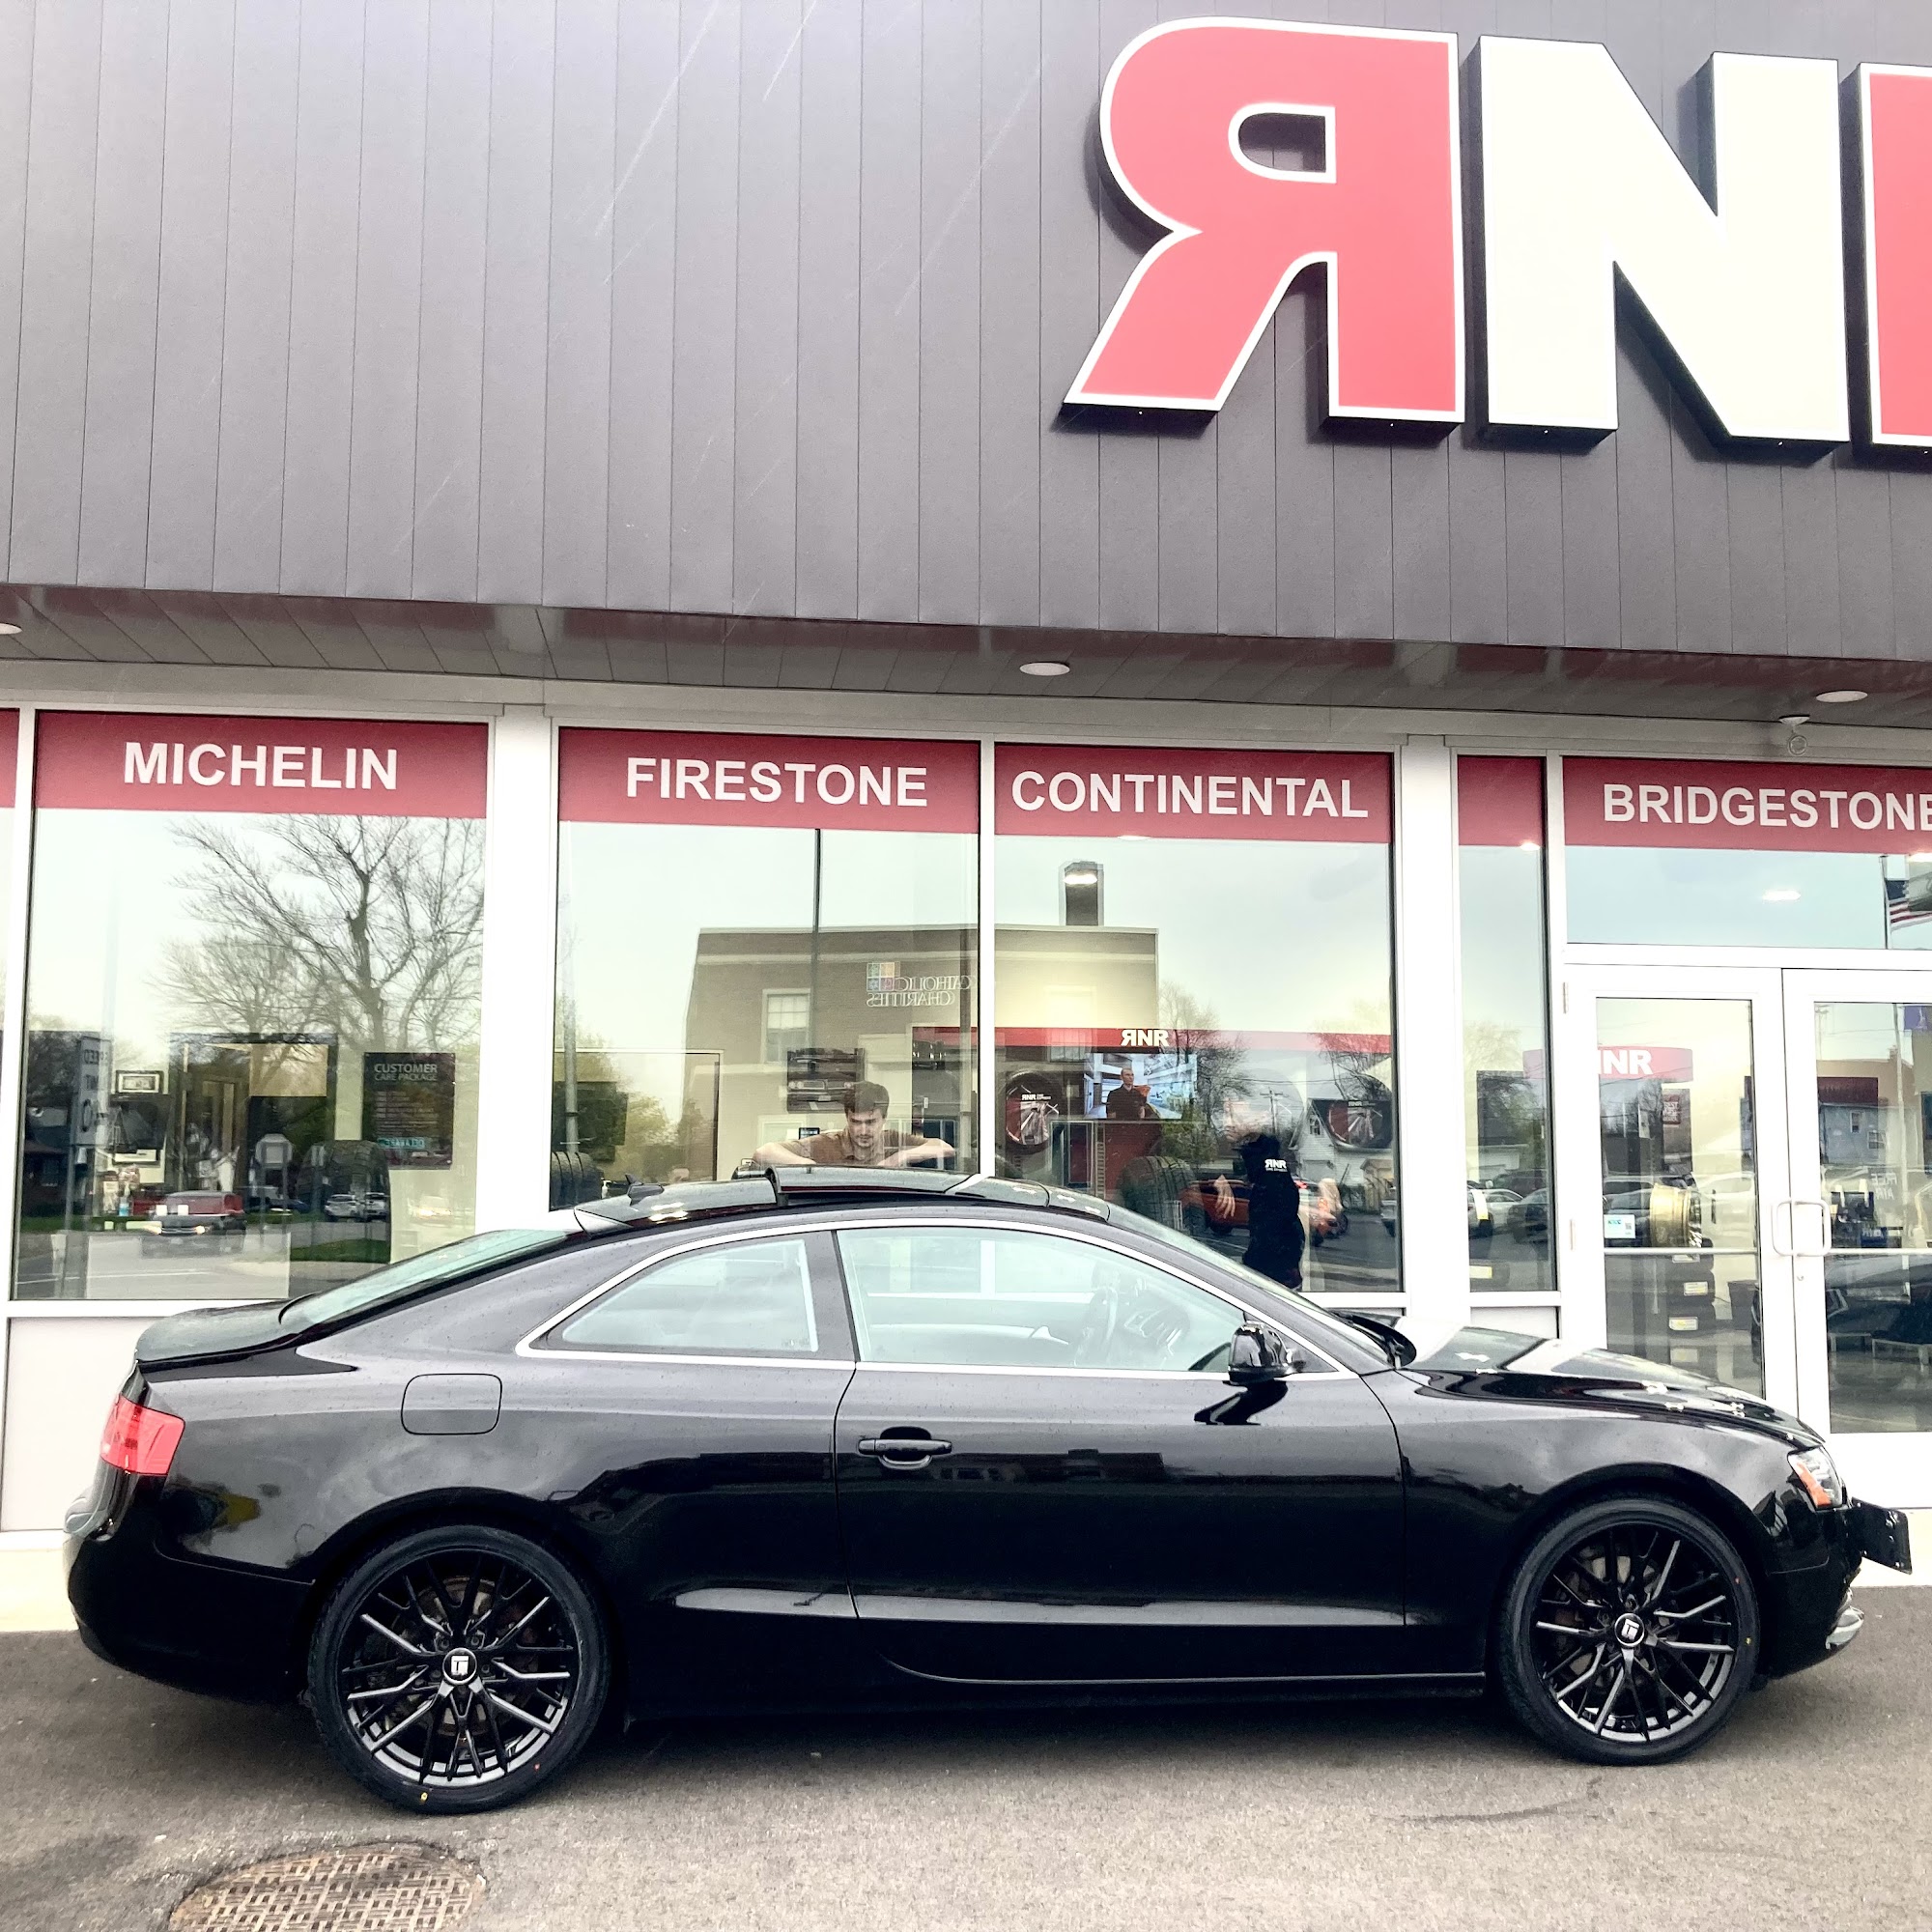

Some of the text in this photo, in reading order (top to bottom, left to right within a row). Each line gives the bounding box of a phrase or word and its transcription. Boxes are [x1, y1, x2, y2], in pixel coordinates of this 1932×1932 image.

[1063, 15, 1932, 447] RN
[125, 742, 397, 790] MICHELIN
[626, 756, 928, 808] FIRESTONE
[1011, 770, 1369, 819] CONTINENTAL
[374, 1063, 438, 1073] CUSTOMER
[374, 1072, 397, 1081] CARE
[1597, 1049, 1654, 1075] NR
